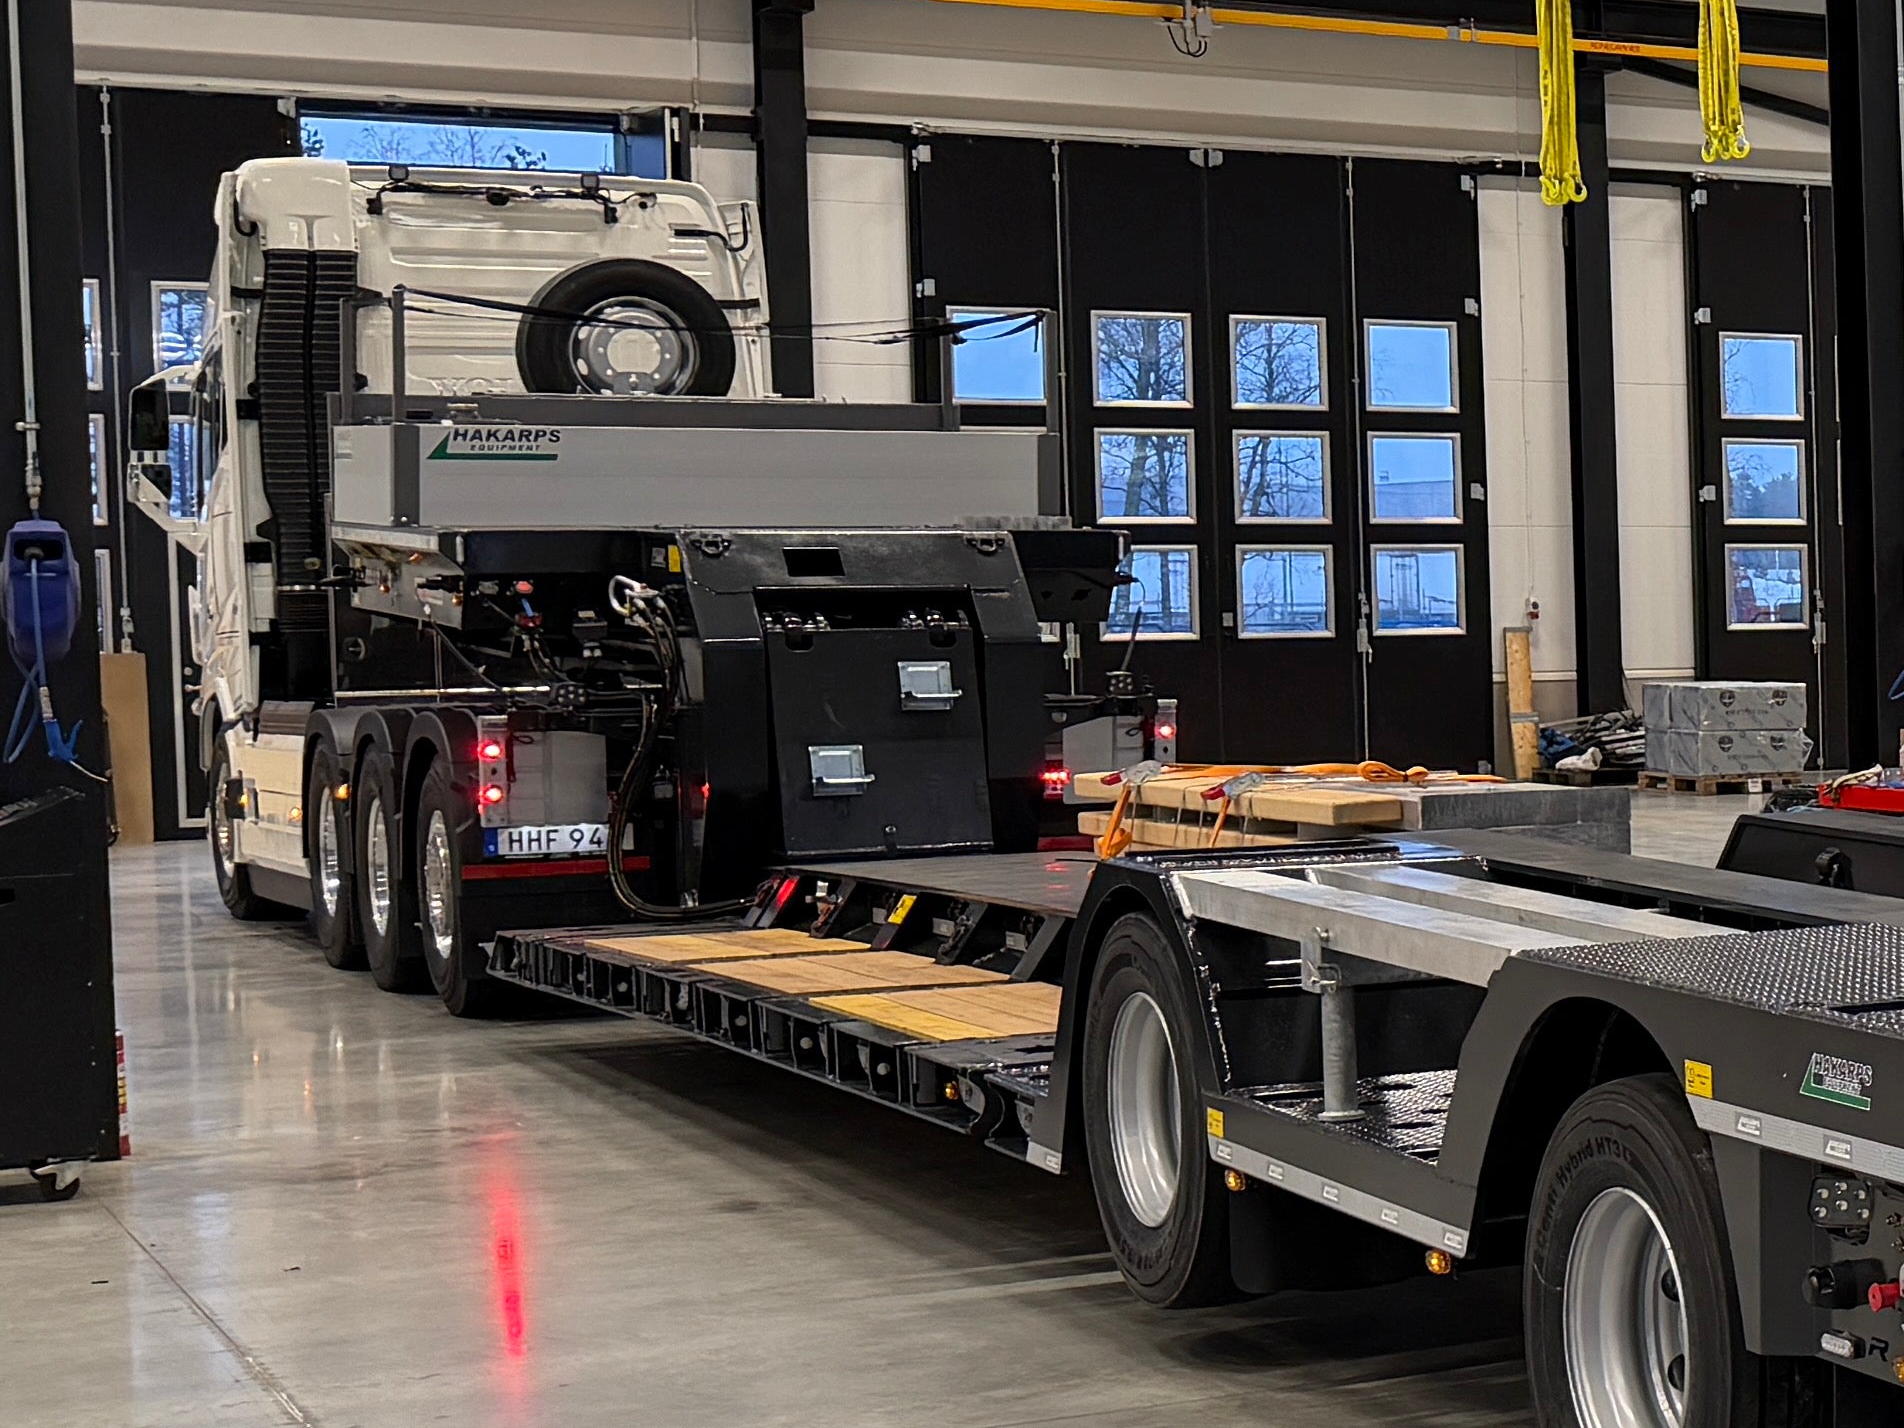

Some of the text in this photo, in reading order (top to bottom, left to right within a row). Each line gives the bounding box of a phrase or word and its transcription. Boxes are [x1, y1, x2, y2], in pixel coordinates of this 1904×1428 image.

[452, 427, 561, 443] HAKARPS
[469, 444, 541, 452] EQUIPMENT
[508, 828, 559, 853] HHF
[1868, 1336, 1889, 1362] R
